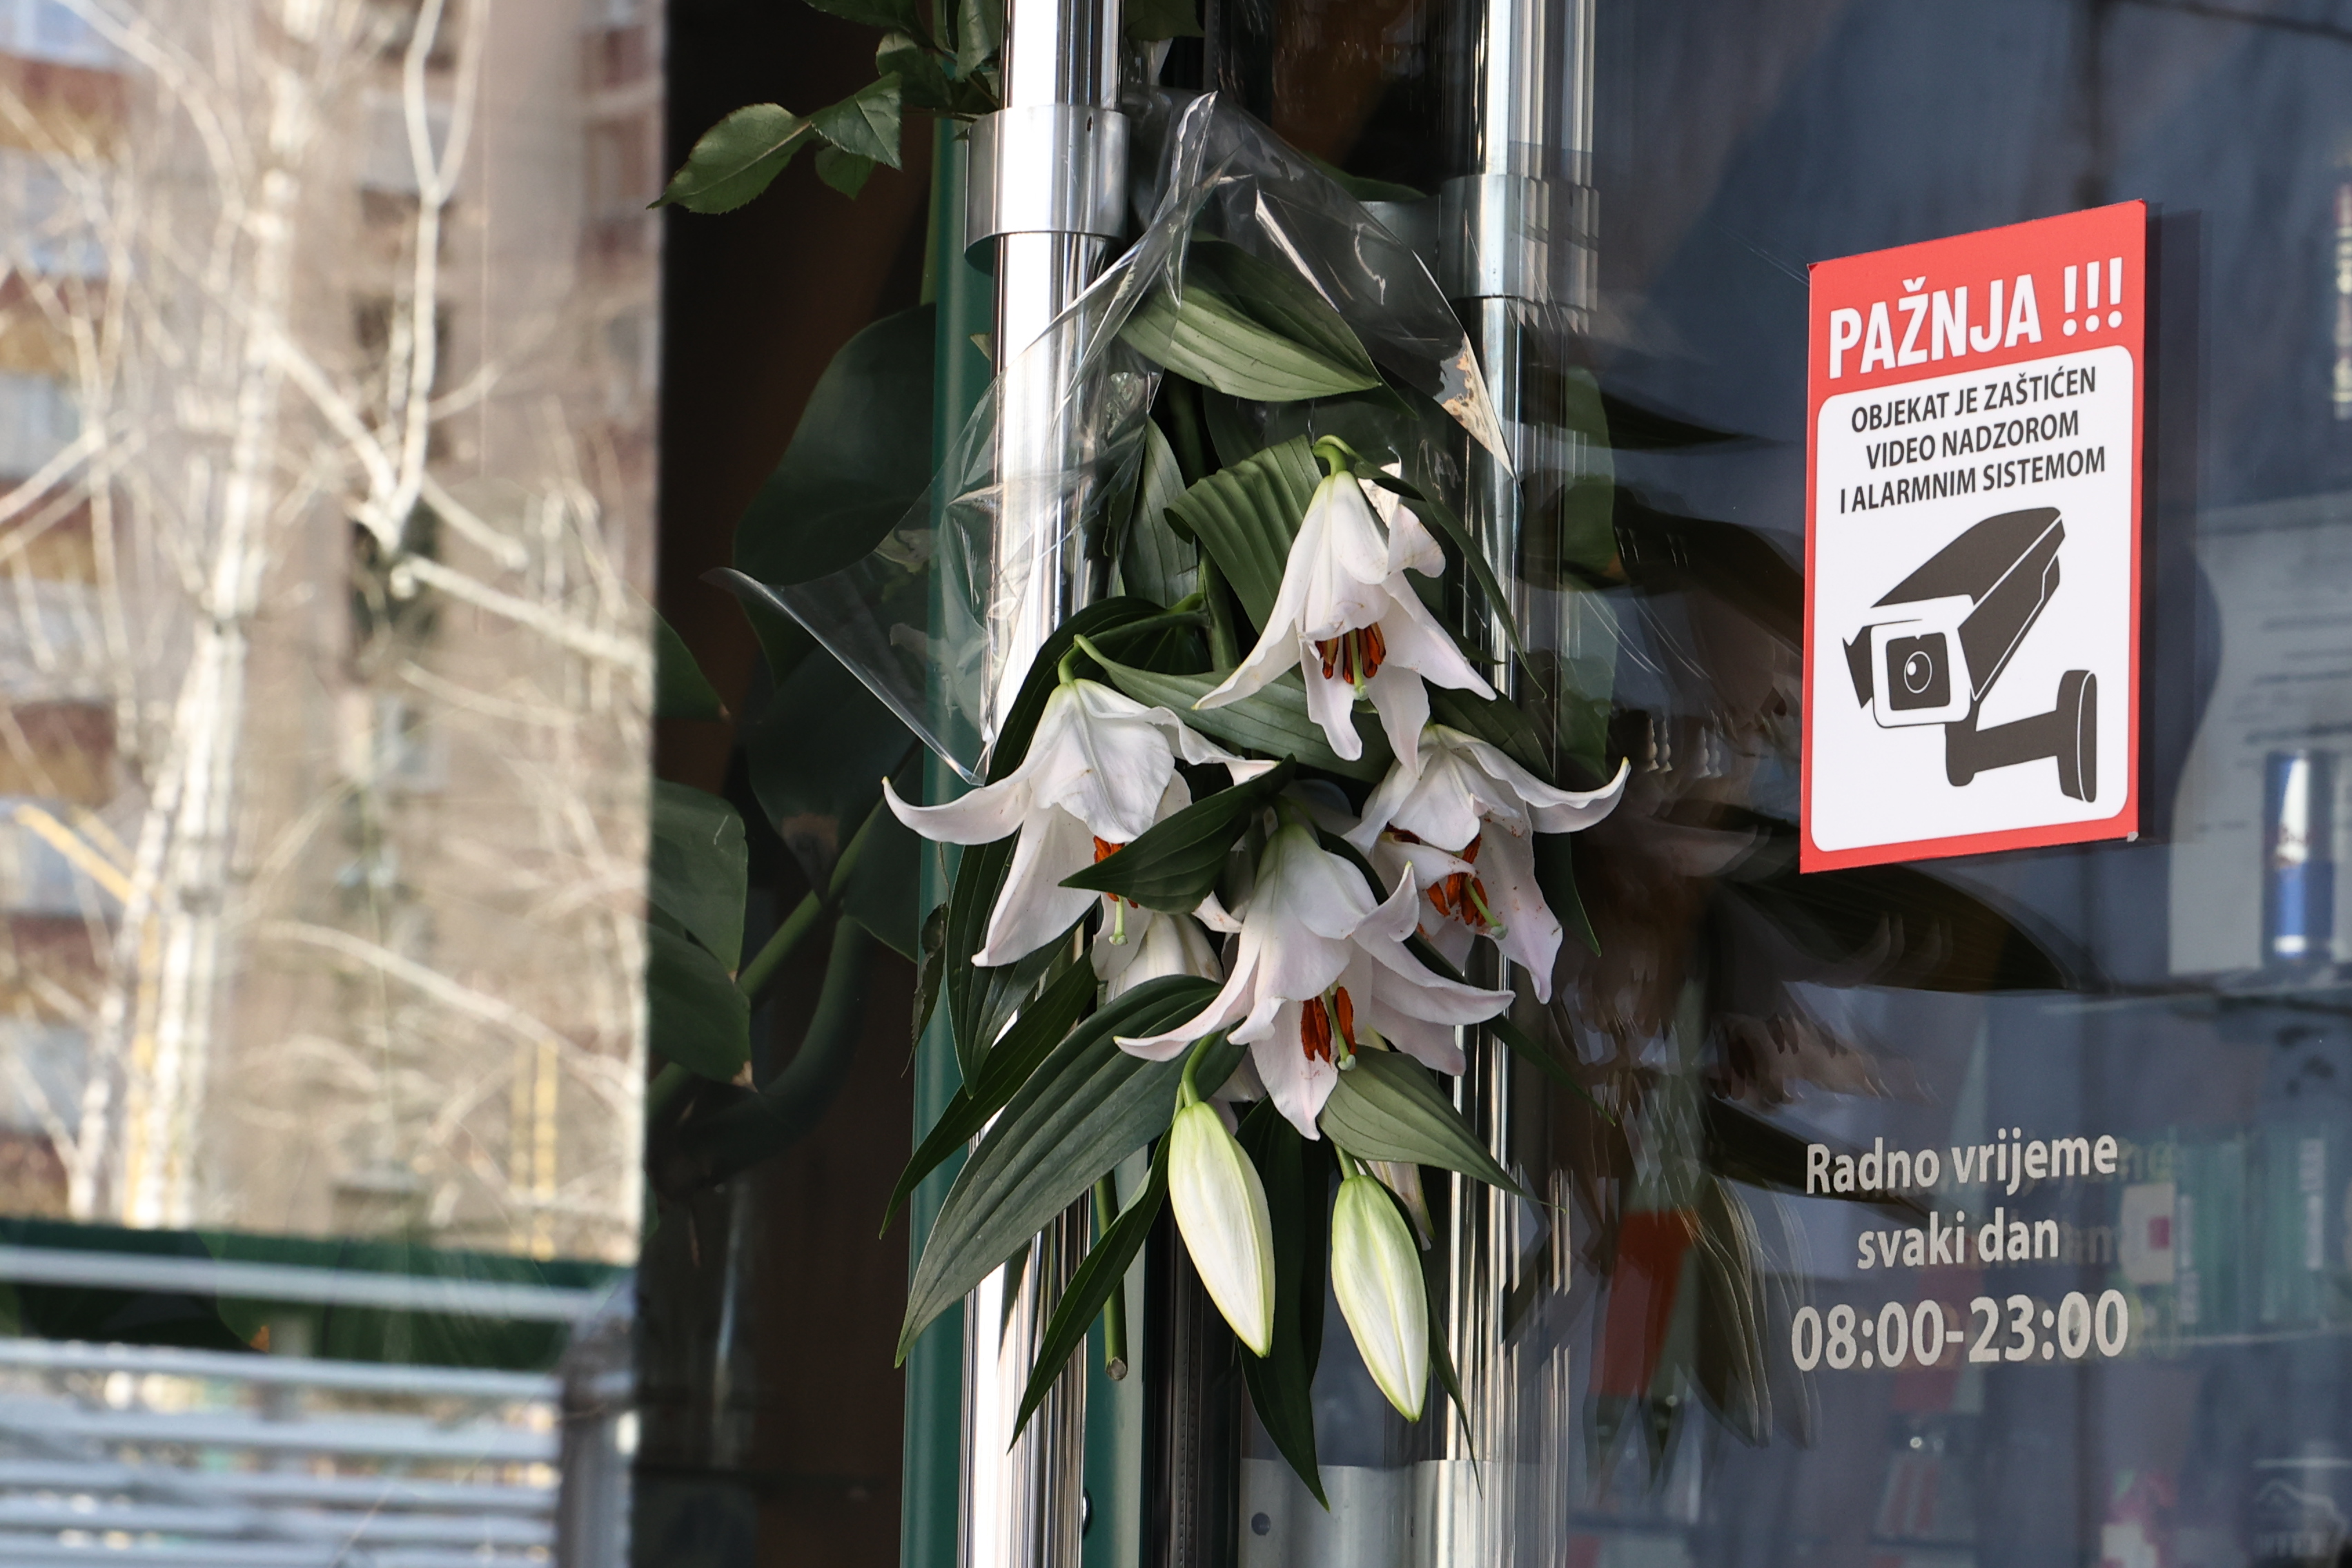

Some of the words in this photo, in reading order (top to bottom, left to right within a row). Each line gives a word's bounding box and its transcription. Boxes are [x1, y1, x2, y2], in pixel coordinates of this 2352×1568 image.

[1829, 274, 2041, 379] PAŽNJA
[2063, 257, 2122, 336] !!!
[1851, 392, 1950, 432] OBJEKAT
[1954, 387, 1977, 415] JE
[1985, 366, 2096, 409] ZAŠTIĆEN
[1866, 434, 1935, 469] VIDEO
[1942, 410, 2079, 458] NADZOROM
[1841, 488, 1846, 513] I
[1852, 468, 1976, 512] ALARMNIM
[1983, 446, 2106, 491] SISTEMOM
[1806, 1137, 1940, 1195] Radno
[1951, 1127, 2118, 1195] vrijeme
[1857, 1211, 1966, 1269] svaki
[1978, 1207, 2059, 1262] dan
[1792, 1288, 2129, 1372] 08:00-23:00
